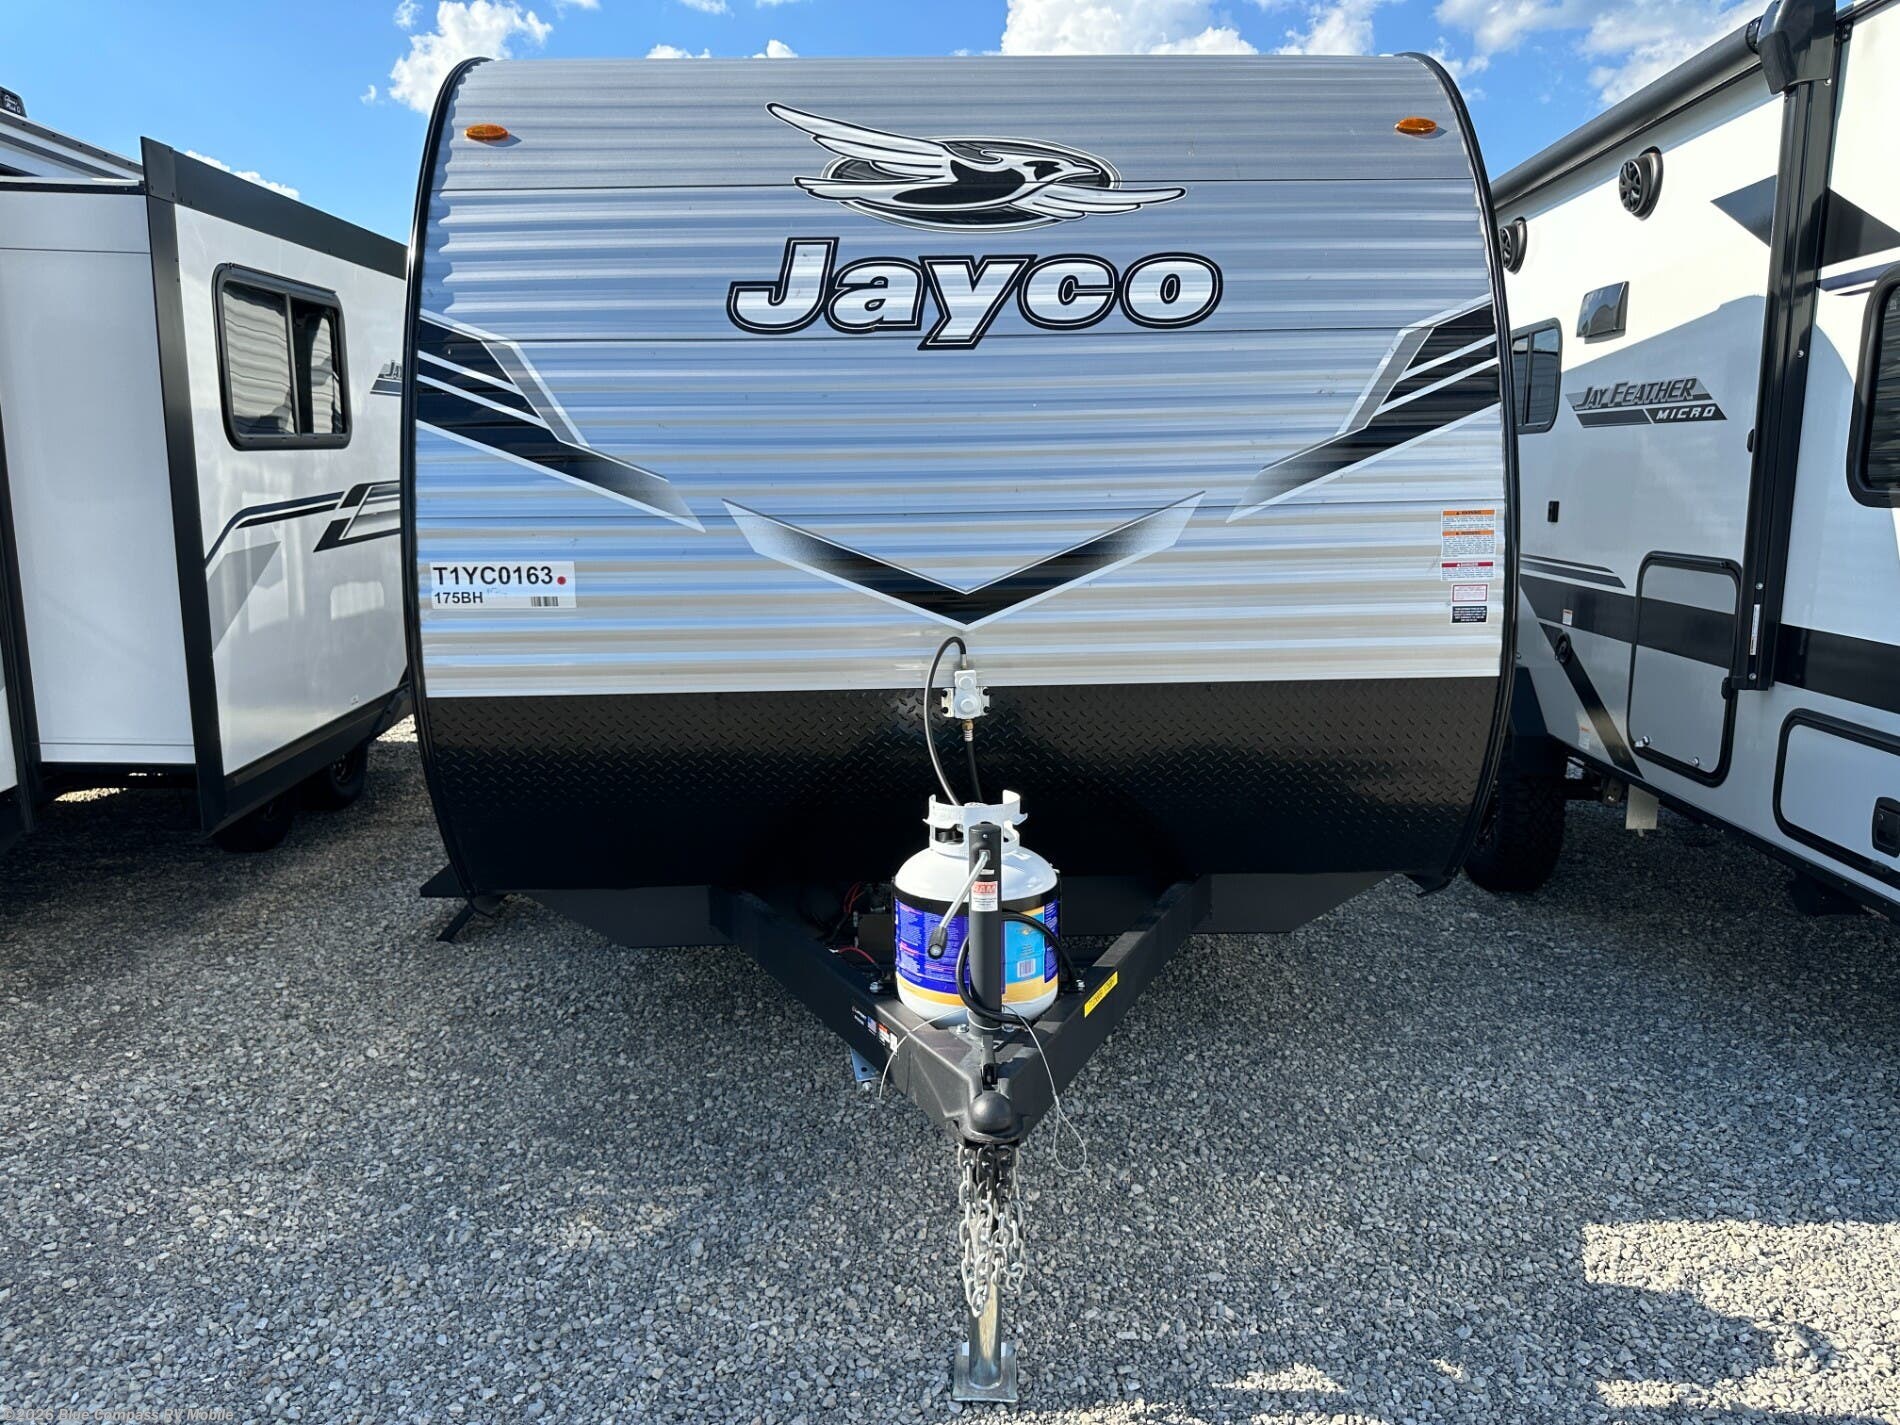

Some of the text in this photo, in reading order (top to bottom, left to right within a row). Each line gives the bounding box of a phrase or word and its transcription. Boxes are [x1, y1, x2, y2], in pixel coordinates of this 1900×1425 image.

[726, 237, 1224, 350] Jayco
[1575, 376, 1698, 410] JAY FEATHER
[1656, 406, 1716, 420] MICRO
[432, 566, 553, 585] T1YC0163
[434, 591, 483, 604] 175BH
